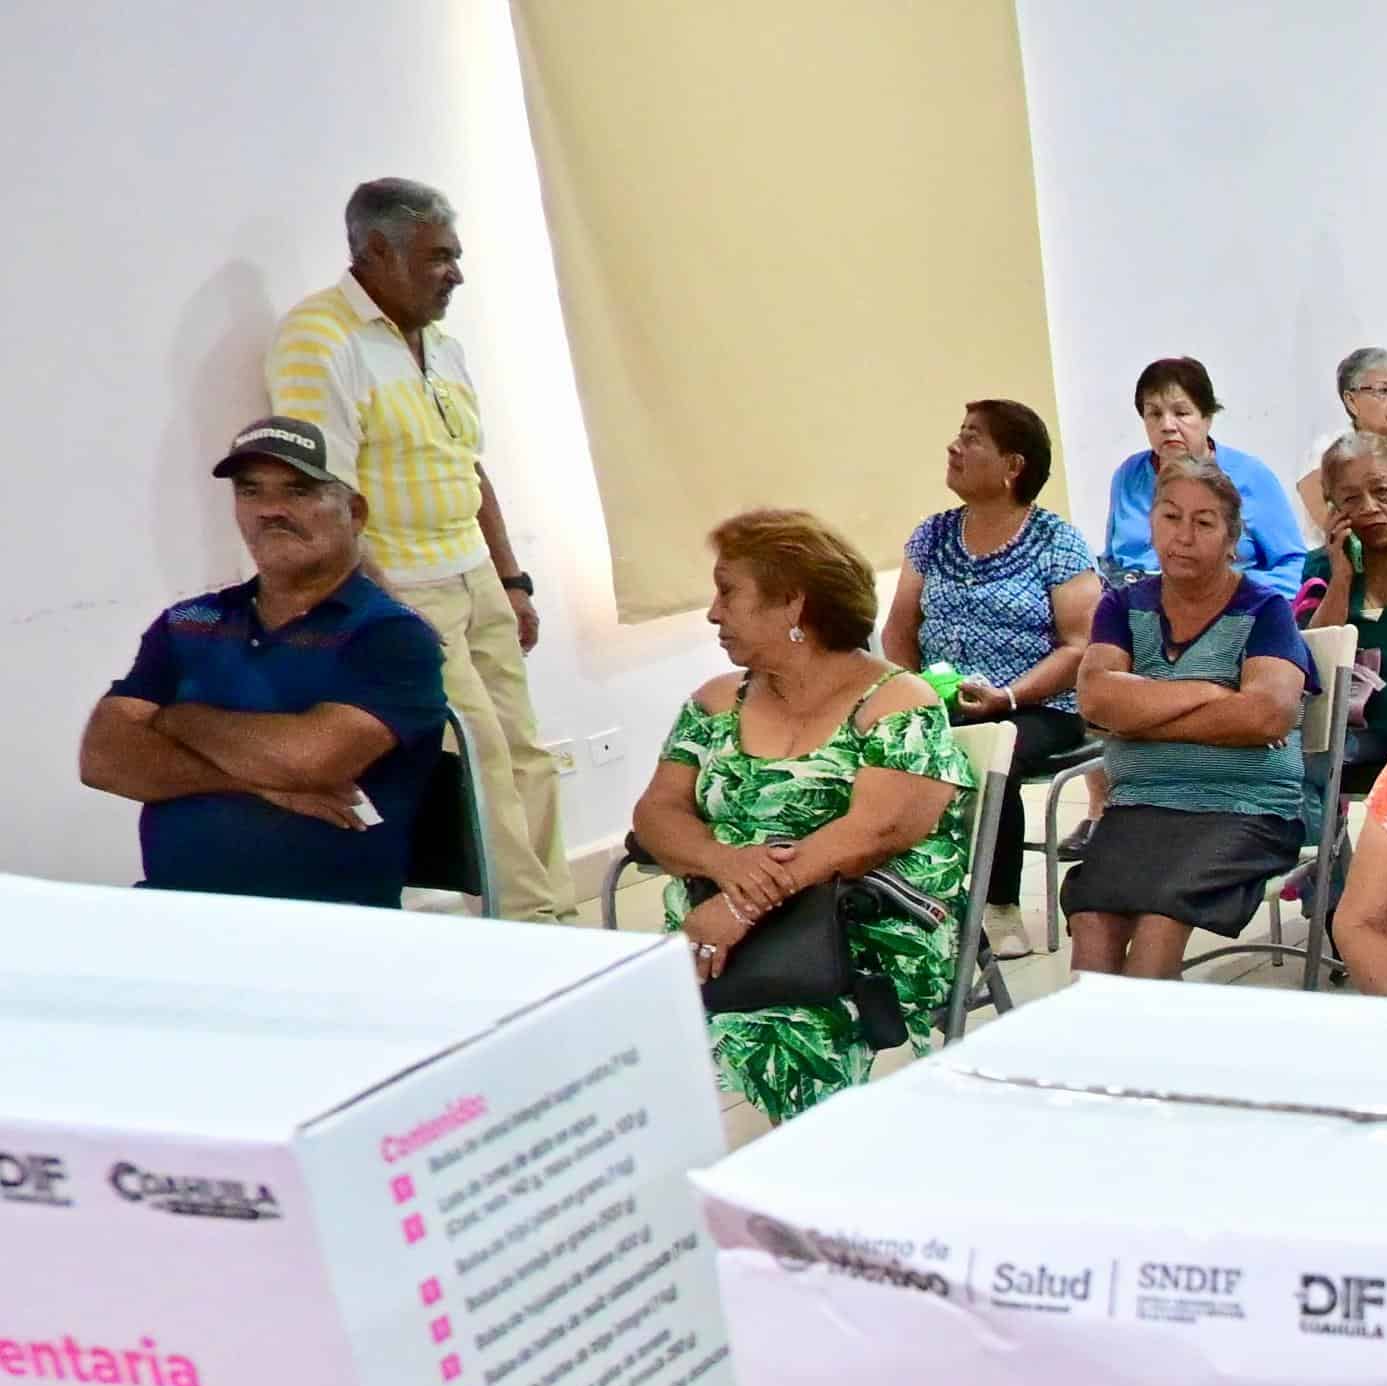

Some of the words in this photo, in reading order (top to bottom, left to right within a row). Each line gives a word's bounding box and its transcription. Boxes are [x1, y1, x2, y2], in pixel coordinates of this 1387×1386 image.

[992, 1262, 1092, 1302] Salud
[1138, 1262, 1242, 1296] SNDIF
[1300, 1273, 1387, 1321] DIF
